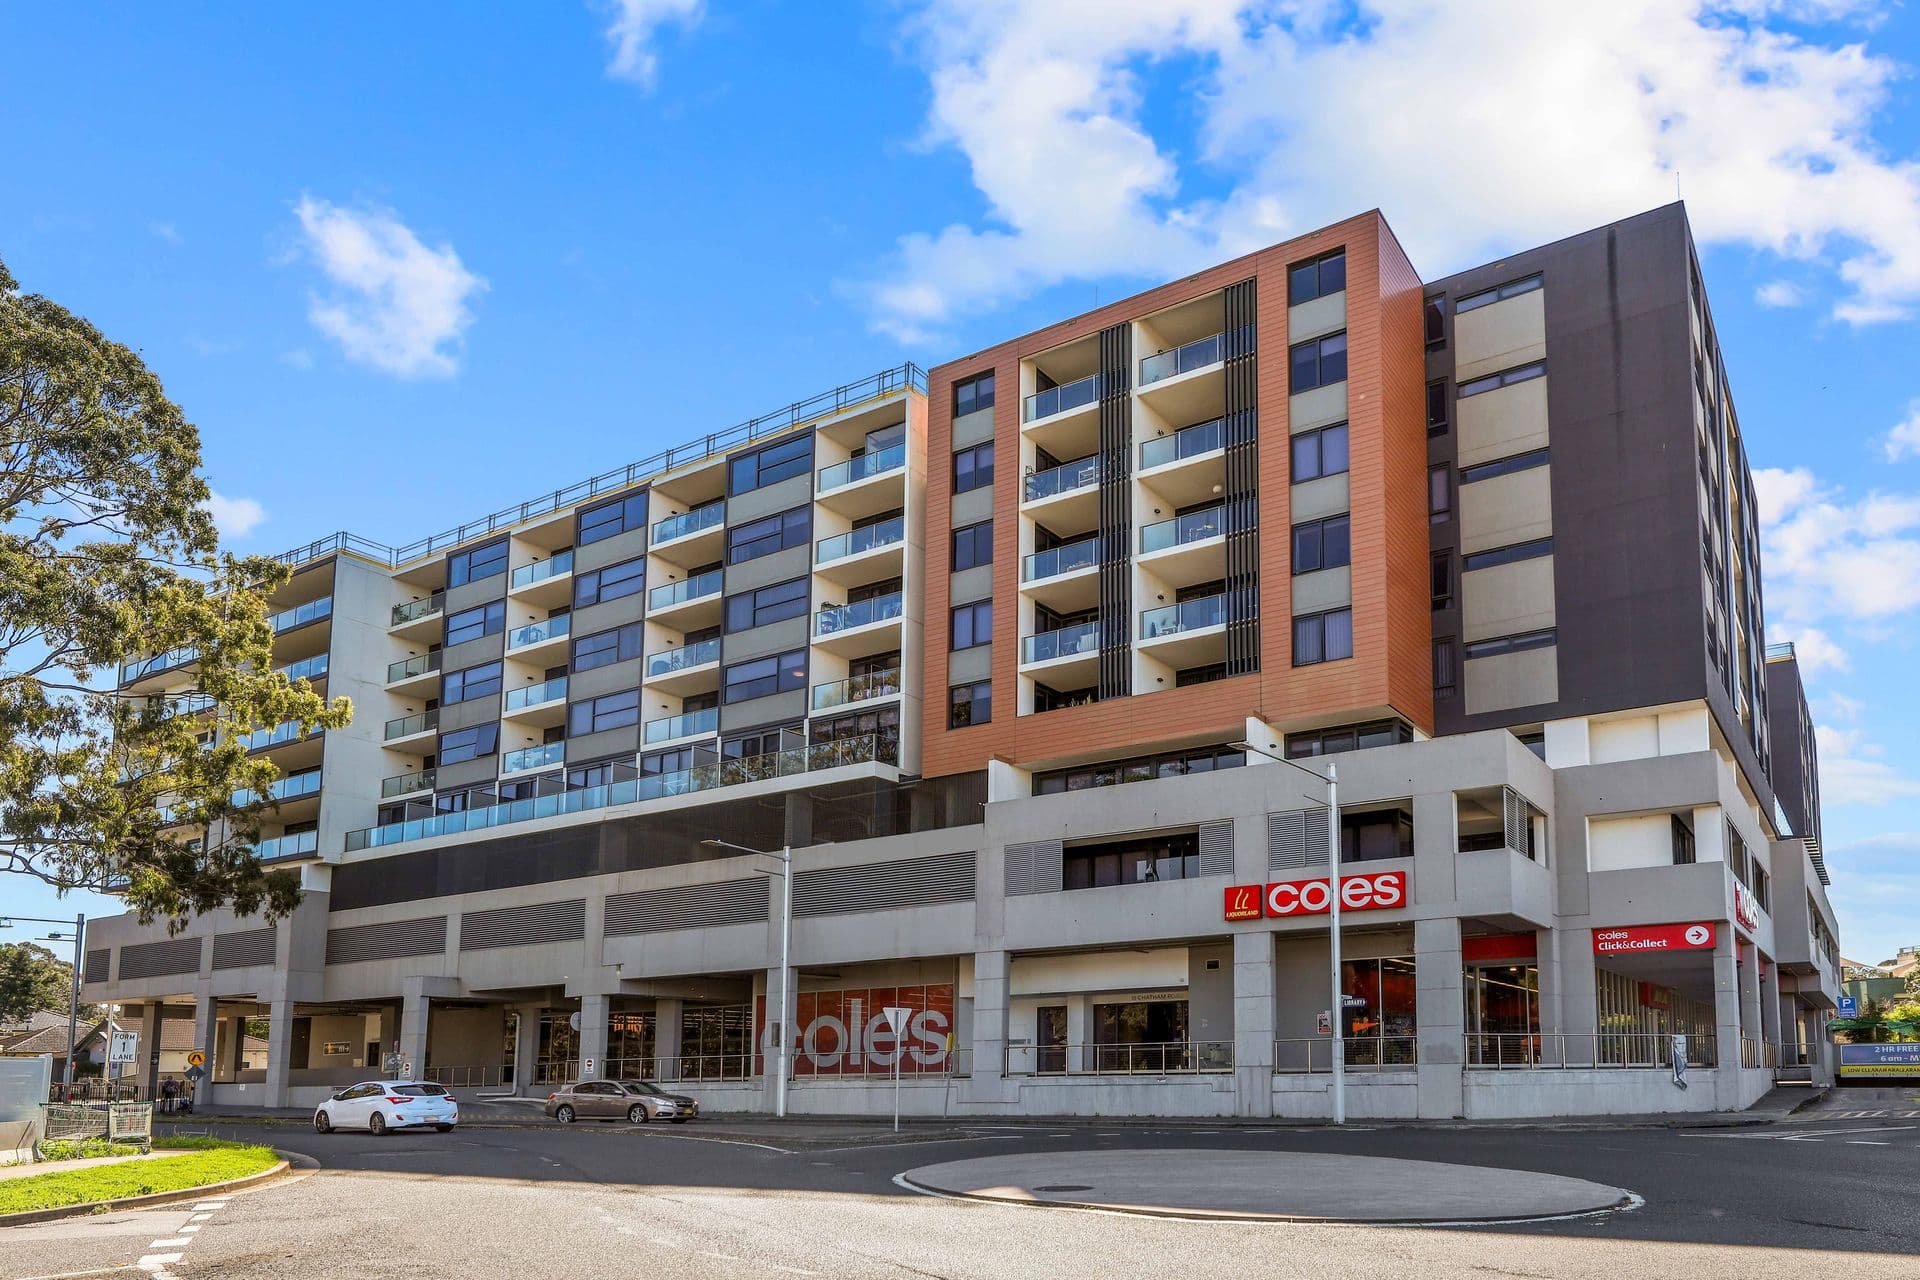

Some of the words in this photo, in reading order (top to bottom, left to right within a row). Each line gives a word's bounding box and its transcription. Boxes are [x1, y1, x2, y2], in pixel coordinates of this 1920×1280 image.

[1269, 875, 1400, 913] coes
[1226, 910, 1258, 918] LIQUORLAND
[1598, 931, 1628, 940] coles
[1598, 939, 1667, 950] Click&Collect
[1843, 999, 1851, 1007] P
[760, 999, 949, 1067] oles
[122, 1041, 126, 1052] 1
